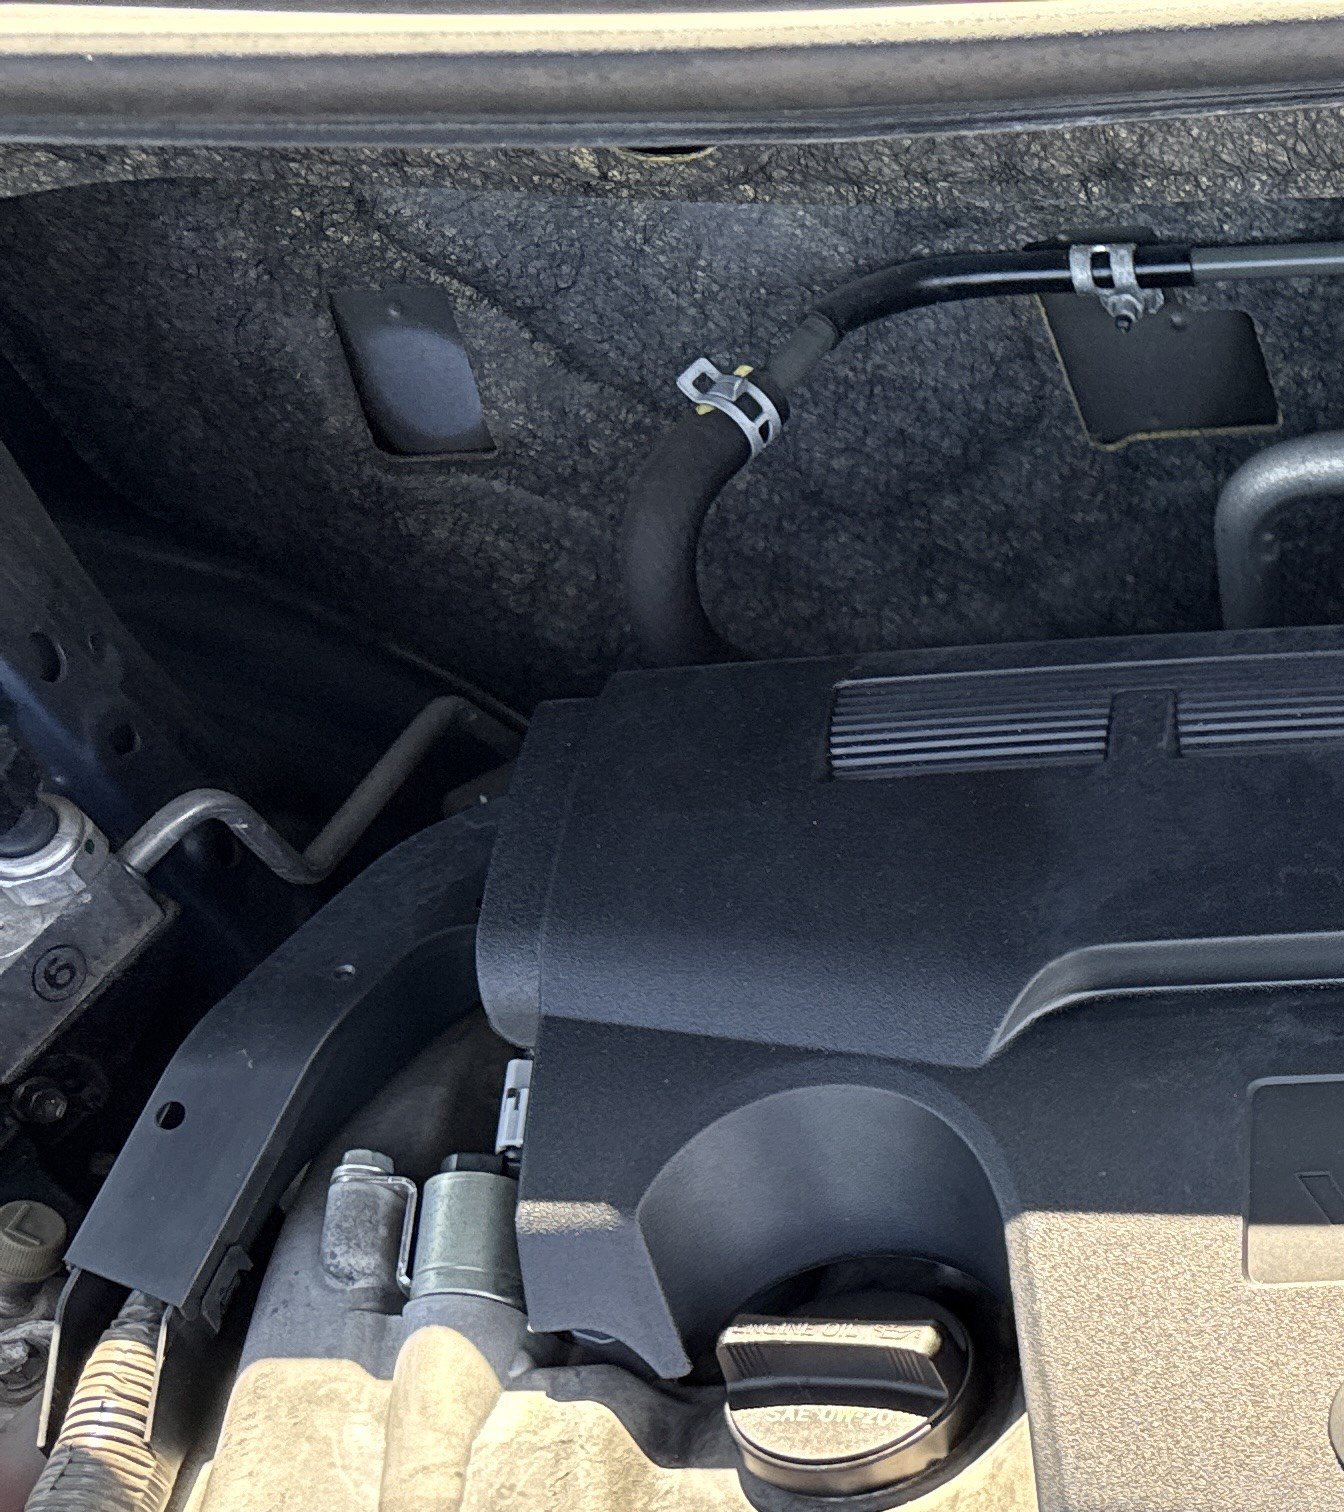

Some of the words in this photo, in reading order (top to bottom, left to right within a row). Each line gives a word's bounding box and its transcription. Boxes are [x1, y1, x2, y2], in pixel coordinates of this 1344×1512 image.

[822, 1322, 858, 1339] OIL
[765, 1408, 811, 1422] SAE
[817, 1408, 893, 1426] 0W-20
